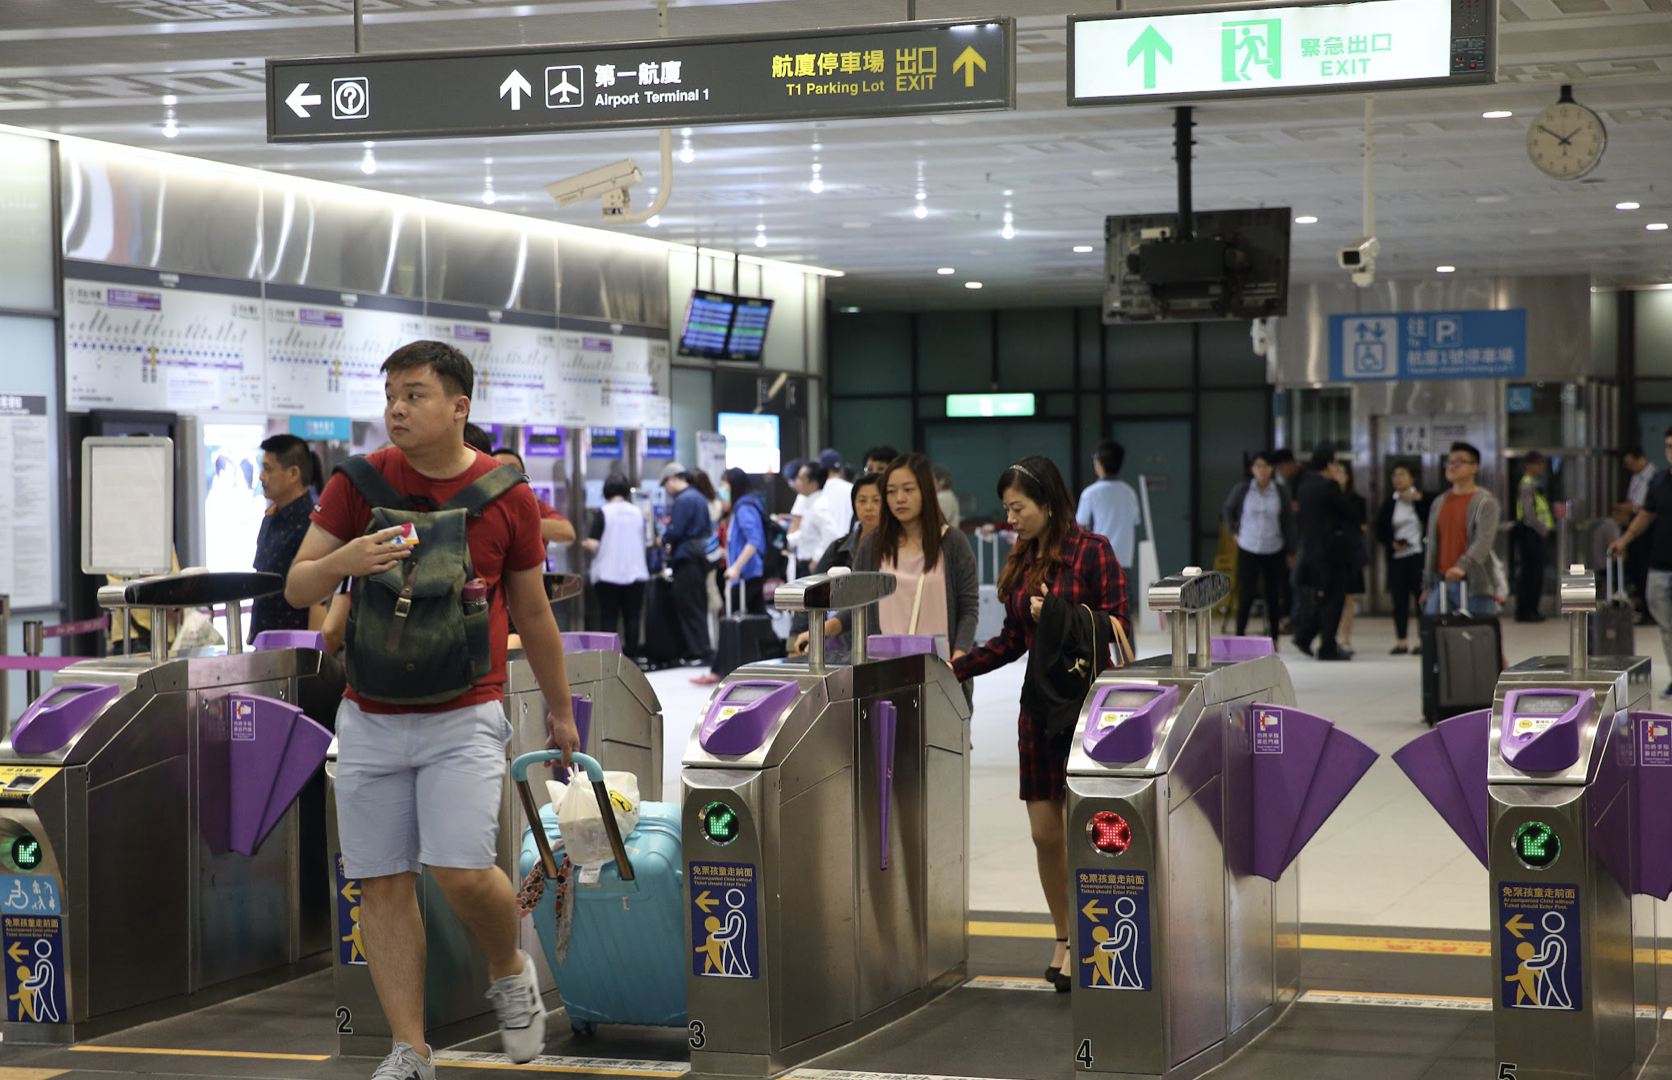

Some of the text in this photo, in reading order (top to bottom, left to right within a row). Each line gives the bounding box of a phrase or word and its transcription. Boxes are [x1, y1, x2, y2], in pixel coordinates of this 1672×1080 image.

[1301, 33, 1391, 57] 緊急出口
[772, 50, 885, 78] 航廈停車場
[895, 47, 937, 75] 出口
[1321, 58, 1371, 76] EXIT
[594, 60, 682, 88] 第一航廈
[896, 74, 937, 92] EXIT
[595, 88, 709, 108] Airport Terminal 1
[786, 80, 885, 96] T1 Parking Lot
[1435, 320, 1456, 344] P
[692, 865, 753, 877] 免票孩童走前面
[1079, 873, 1145, 885] 免票孩童走前面
[1502, 886, 1575, 898] 免票孩童走前面
[336, 1006, 353, 1034] 2
[688, 1020, 706, 1049] 3
[1075, 1039, 1094, 1068] 4
